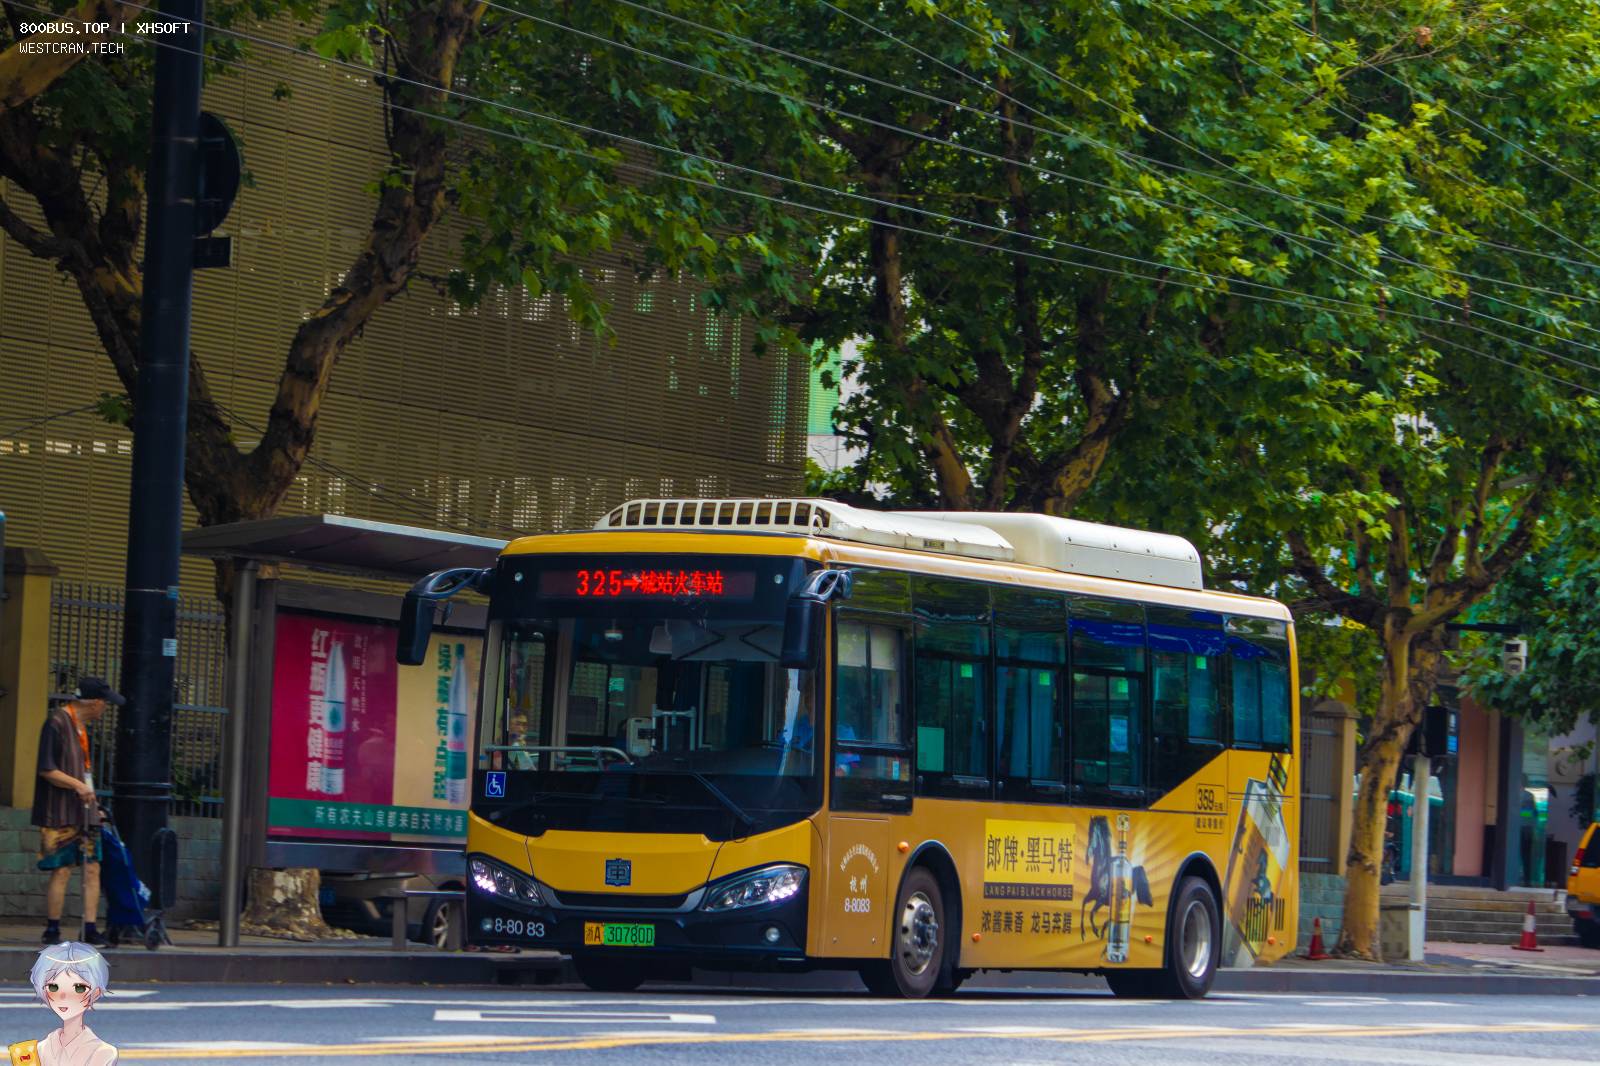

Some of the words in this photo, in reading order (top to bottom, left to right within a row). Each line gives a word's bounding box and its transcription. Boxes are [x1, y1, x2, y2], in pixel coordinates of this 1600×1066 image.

[576, 570, 623, 596] 325
[640, 570, 724, 596] 城站火车站
[314, 805, 464, 833] 所有农夫山泉都来自天然水源
[844, 897, 871, 912] 8-8083
